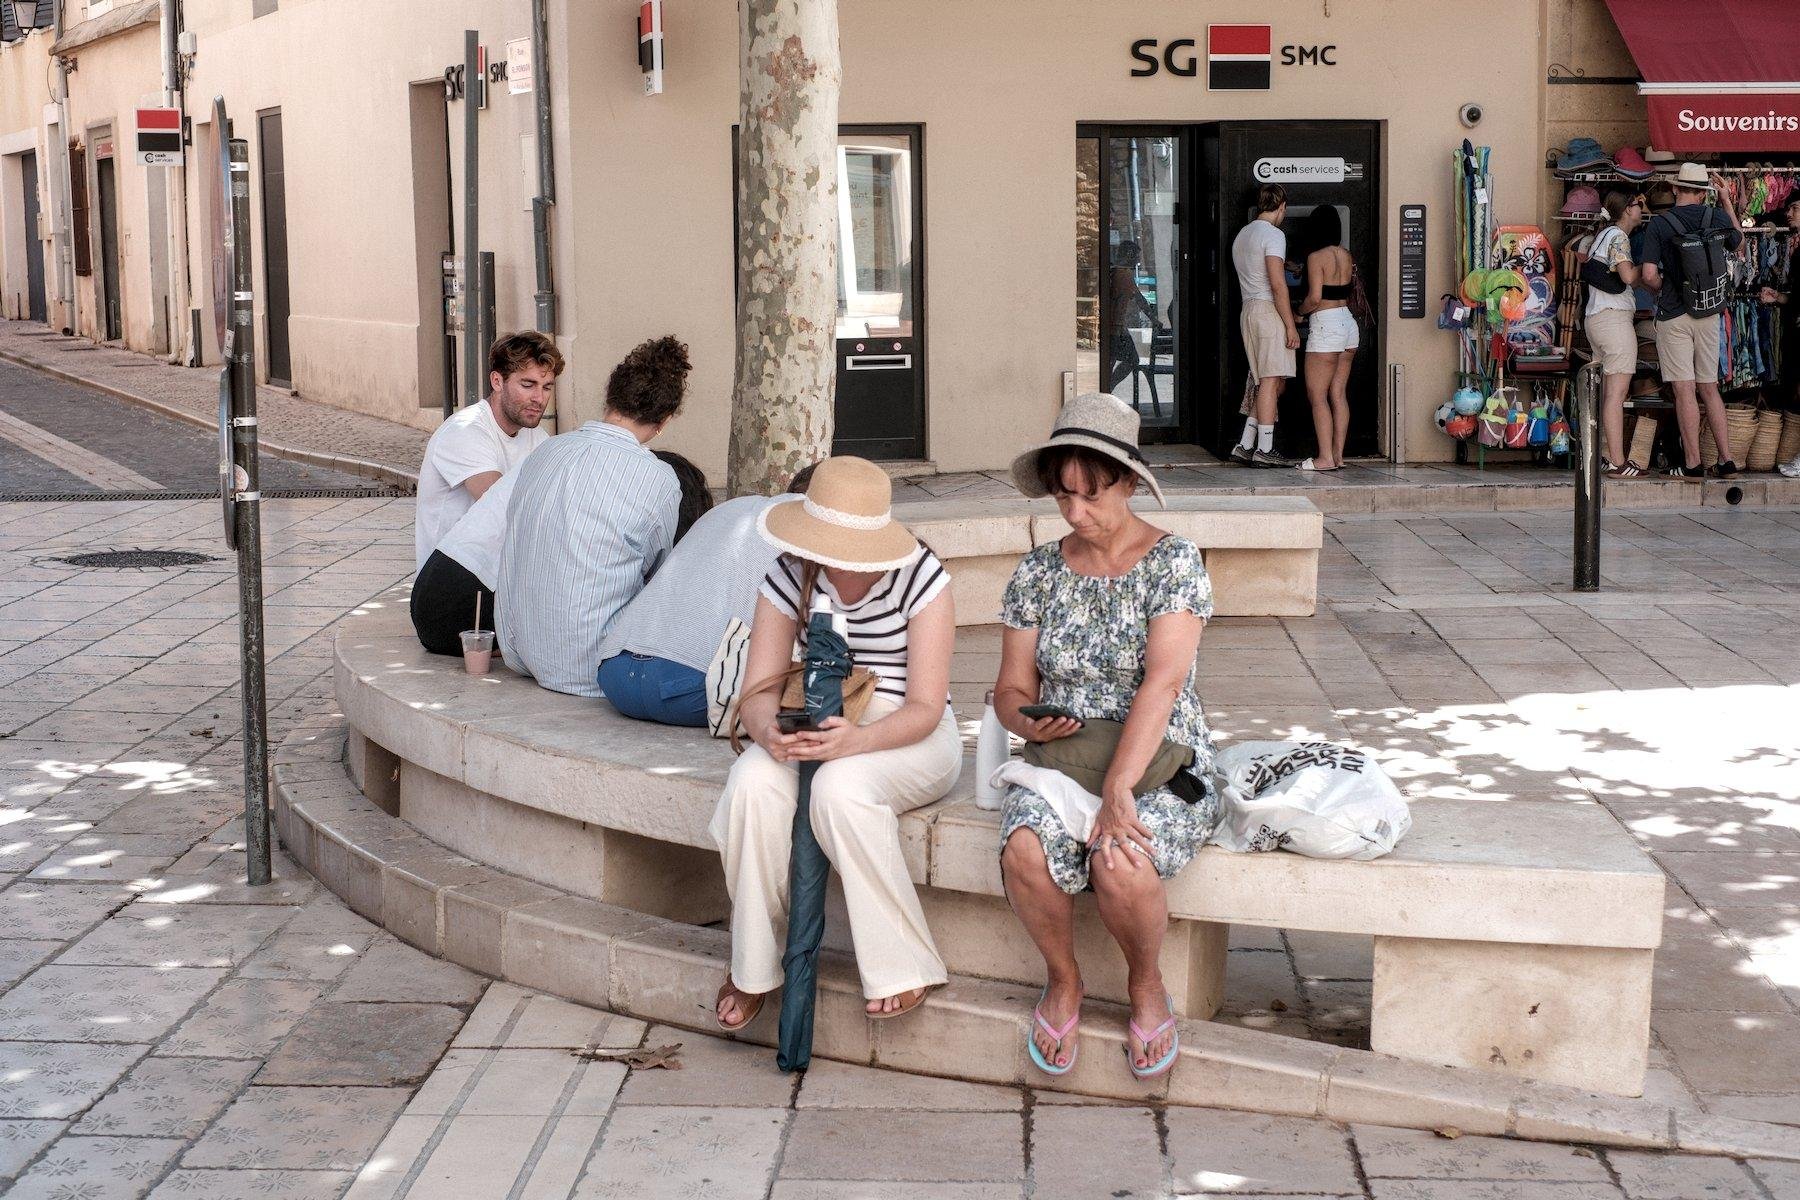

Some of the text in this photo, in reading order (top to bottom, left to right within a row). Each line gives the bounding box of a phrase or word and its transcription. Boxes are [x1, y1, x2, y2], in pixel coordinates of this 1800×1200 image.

[1130, 39, 1337, 77] SG SMC
[1677, 109, 1799, 132] Souvenirs
[1273, 164, 1340, 174] cash services
